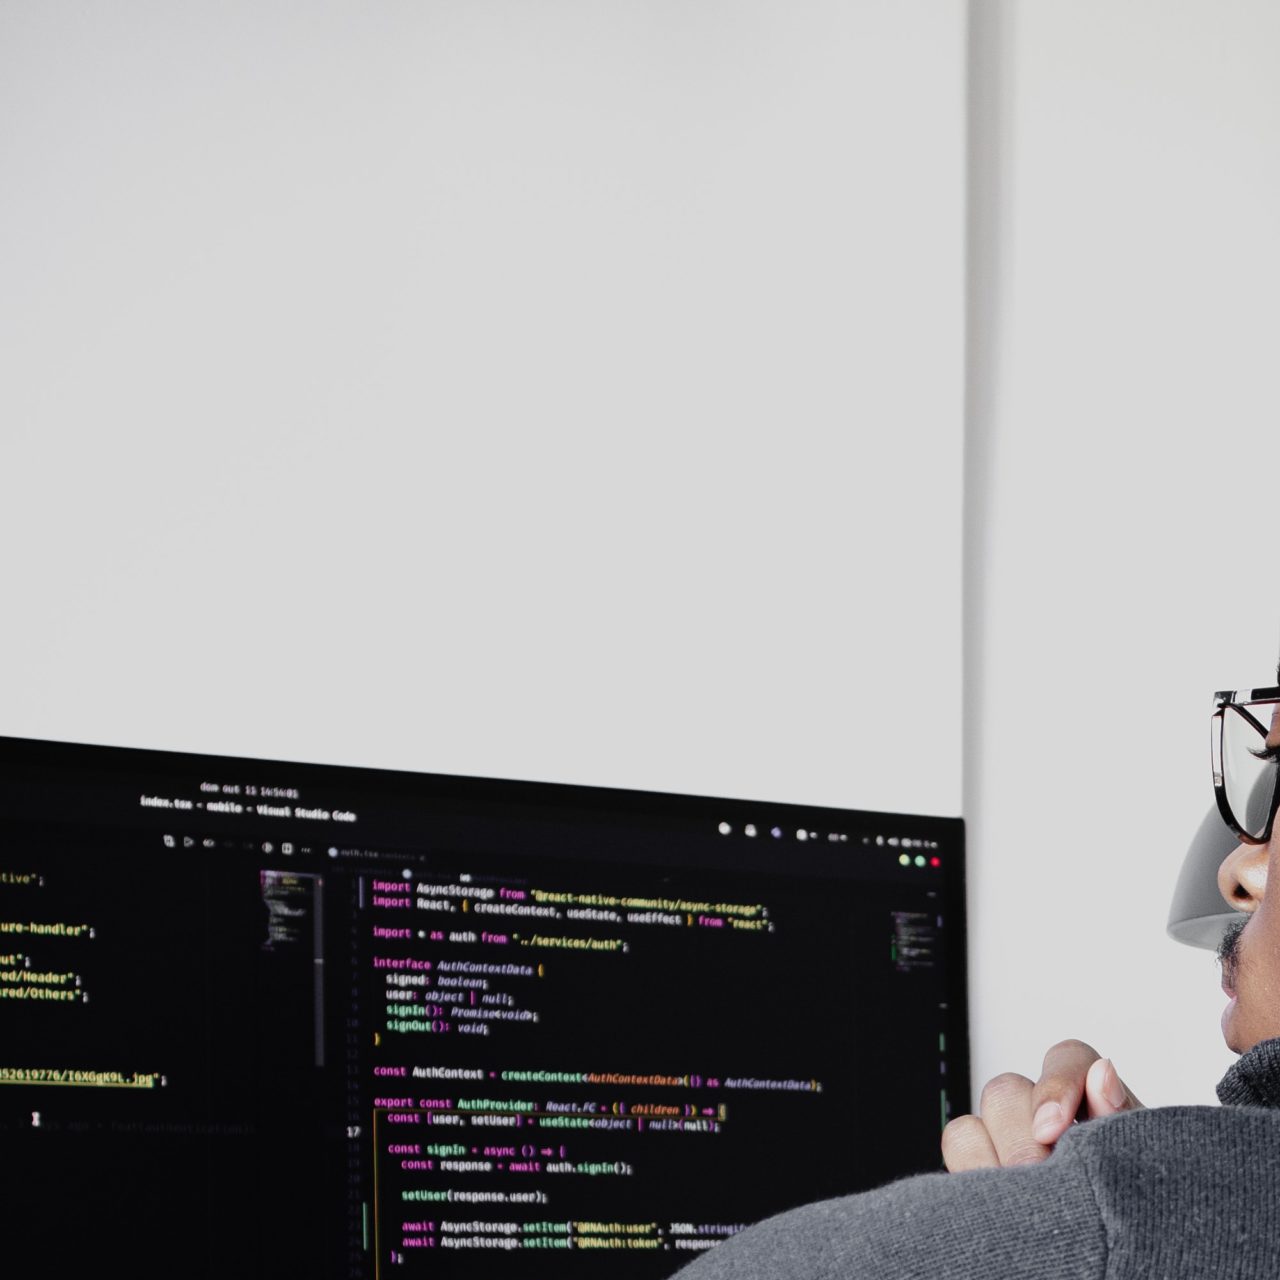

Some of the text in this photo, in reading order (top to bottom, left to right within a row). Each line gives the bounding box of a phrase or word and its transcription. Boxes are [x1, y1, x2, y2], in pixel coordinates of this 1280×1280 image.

[256, 804, 291, 817] Visual
[294, 807, 330, 820] Studio
[331, 810, 357, 822] Code
[372, 879, 411, 893] import
[416, 882, 496, 901] AsyncStorage
[499, 887, 527, 900] from
[372, 894, 411, 909] import
[416, 897, 457, 913] React,
[473, 902, 562, 919] createContext,
[566, 907, 622, 923] useState,
[626, 911, 682, 926] useEffect
[698, 914, 724, 928] from
[727, 916, 774, 932] "react";
[373, 925, 412, 939] import
[448, 930, 478, 943] auth
[481, 931, 508, 945] from
[373, 956, 432, 971] interface
[436, 960, 534, 977] AuthContextData
[0, 969, 82, 987] ed/Header";
[385, 972, 489, 990] signed: boolean;
[0, 986, 89, 1003] red/Others";
[385, 989, 417, 1001] user:
[424, 990, 465, 1003] object
[481, 992, 514, 1007] null;
[386, 1003, 539, 1023] signIn(): Promise<void>;
[386, 1018, 489, 1036] signOut(): void;
[373, 1066, 407, 1077] const
[412, 1065, 484, 1080] AuthContext
[373, 1097, 413, 1112] export
[419, 1098, 451, 1109] const
[457, 1098, 538, 1112] AuthProvider:
[545, 1101, 596, 1113] React.FC
[630, 1103, 680, 1115] children
[387, 1113, 420, 1124] const
[426, 1111, 465, 1127] [user,
[470, 1113, 523, 1127] setUser]
[539, 1115, 632, 1130] useState<object
[648, 1118, 724, 1133] null>(null);
[346, 1125, 361, 1138] 17
[387, 1143, 421, 1155] const
[426, 1143, 467, 1158] signIn
[483, 1146, 516, 1158] async
[400, 1159, 433, 1170] const
[508, 1160, 541, 1173] await
[545, 1161, 633, 1176] auth.signIn();
[401, 1188, 548, 1204] setUser(response.user);
[401, 1220, 749, 1238] await AsyncStorage.setItem("@RNAuth:user", JSON.stringif
[402, 1236, 435, 1248] await
[440, 1235, 670, 1251] AsyncStorage.setItem("@RNAuth:token",
